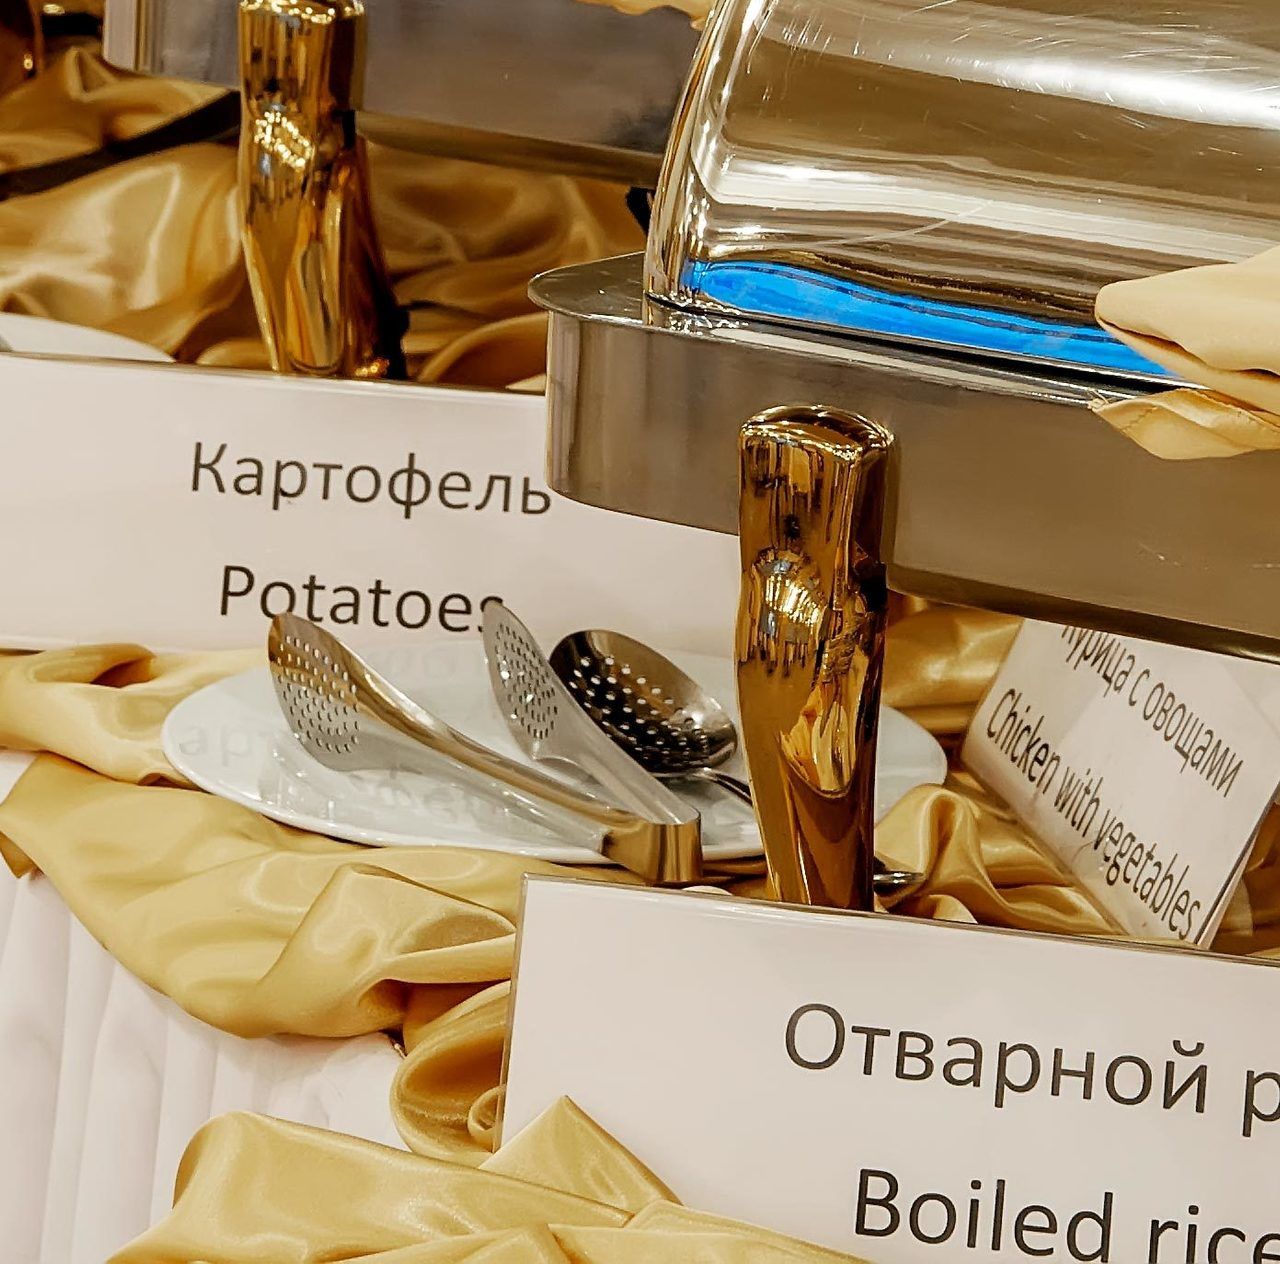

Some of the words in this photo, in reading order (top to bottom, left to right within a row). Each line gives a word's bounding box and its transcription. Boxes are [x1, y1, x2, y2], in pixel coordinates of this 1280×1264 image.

[191, 441, 552, 520] Картофель
[1127, 667, 1150, 707] с
[1142, 681, 1244, 798] овощами
[985, 688, 1062, 795] Chicken
[1053, 765, 1104, 838] with
[1092, 808, 1201, 941] vegetables
[784, 1003, 1209, 1115] Отварной
[855, 1168, 1114, 1264] Boiled
